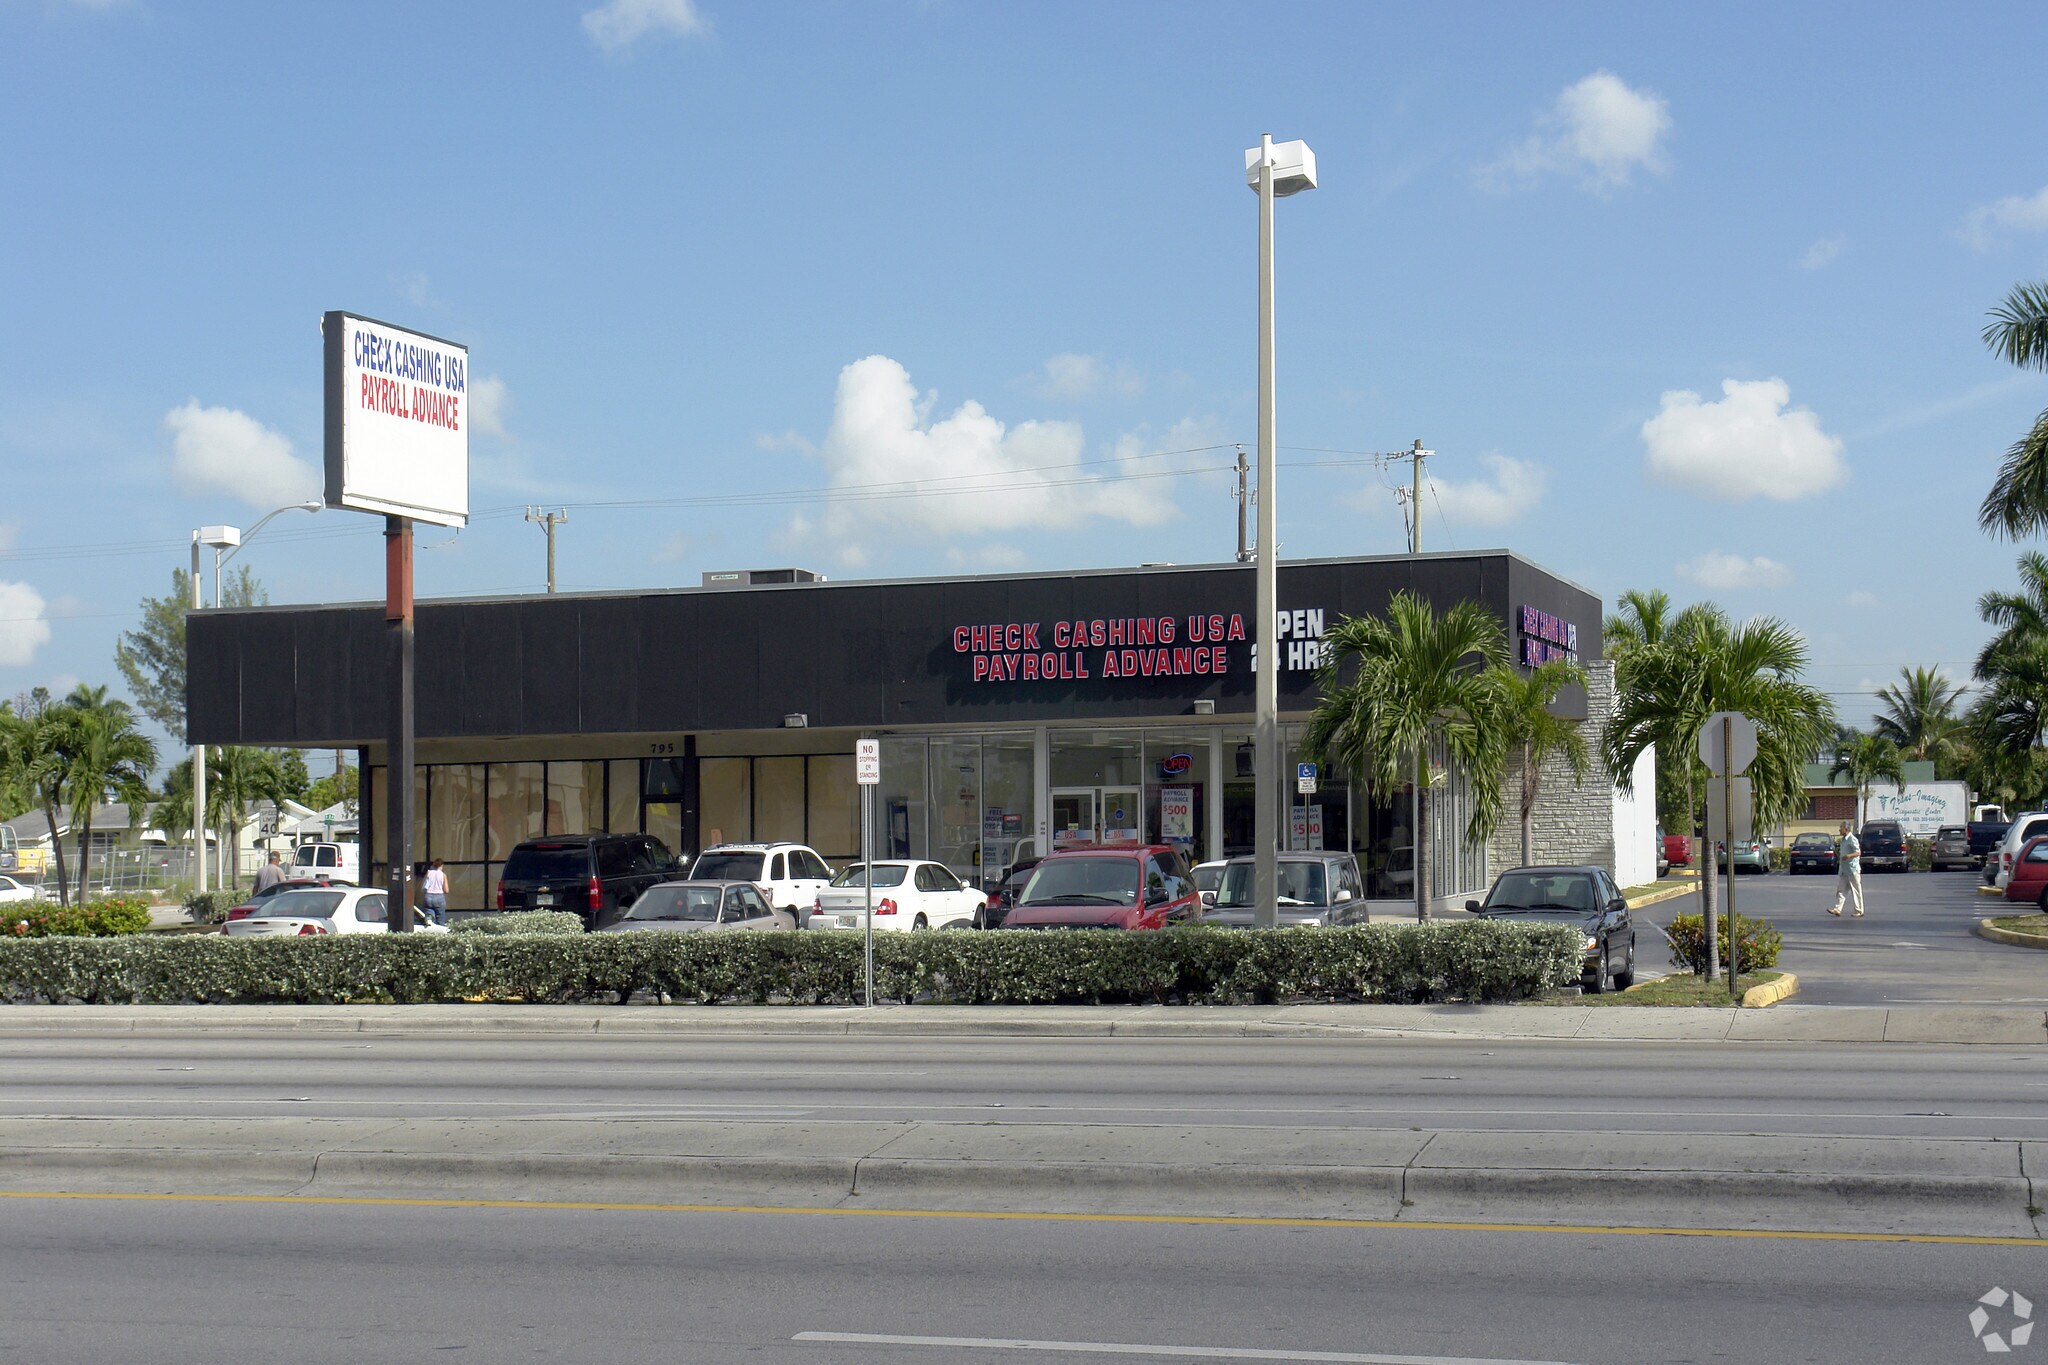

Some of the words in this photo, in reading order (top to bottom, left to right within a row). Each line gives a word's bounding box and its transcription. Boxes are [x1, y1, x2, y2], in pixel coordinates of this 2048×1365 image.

[355, 330, 393, 374] CHECK
[395, 341, 441, 387] CASHING
[445, 356, 465, 393] USA
[361, 373, 408, 418] PAYROLL
[412, 386, 458, 430] ADVANCE
[1277, 608, 1324, 639] PEN
[953, 622, 1040, 653] CHECK
[1054, 616, 1175, 647] CASHING
[1188, 614, 1246, 642] USA
[973, 653, 1089, 683] PAYROLL
[1103, 647, 1227, 678] ADVANCE
[651, 743, 674, 754] 795
[862, 745, 873, 753] NO
[1164, 758, 1192, 769] OPEN
[1163, 804, 1187, 815] $500
[261, 823, 277, 834] 40
[1064, 830, 1077, 839] USA
[1113, 830, 1124, 839] USA
